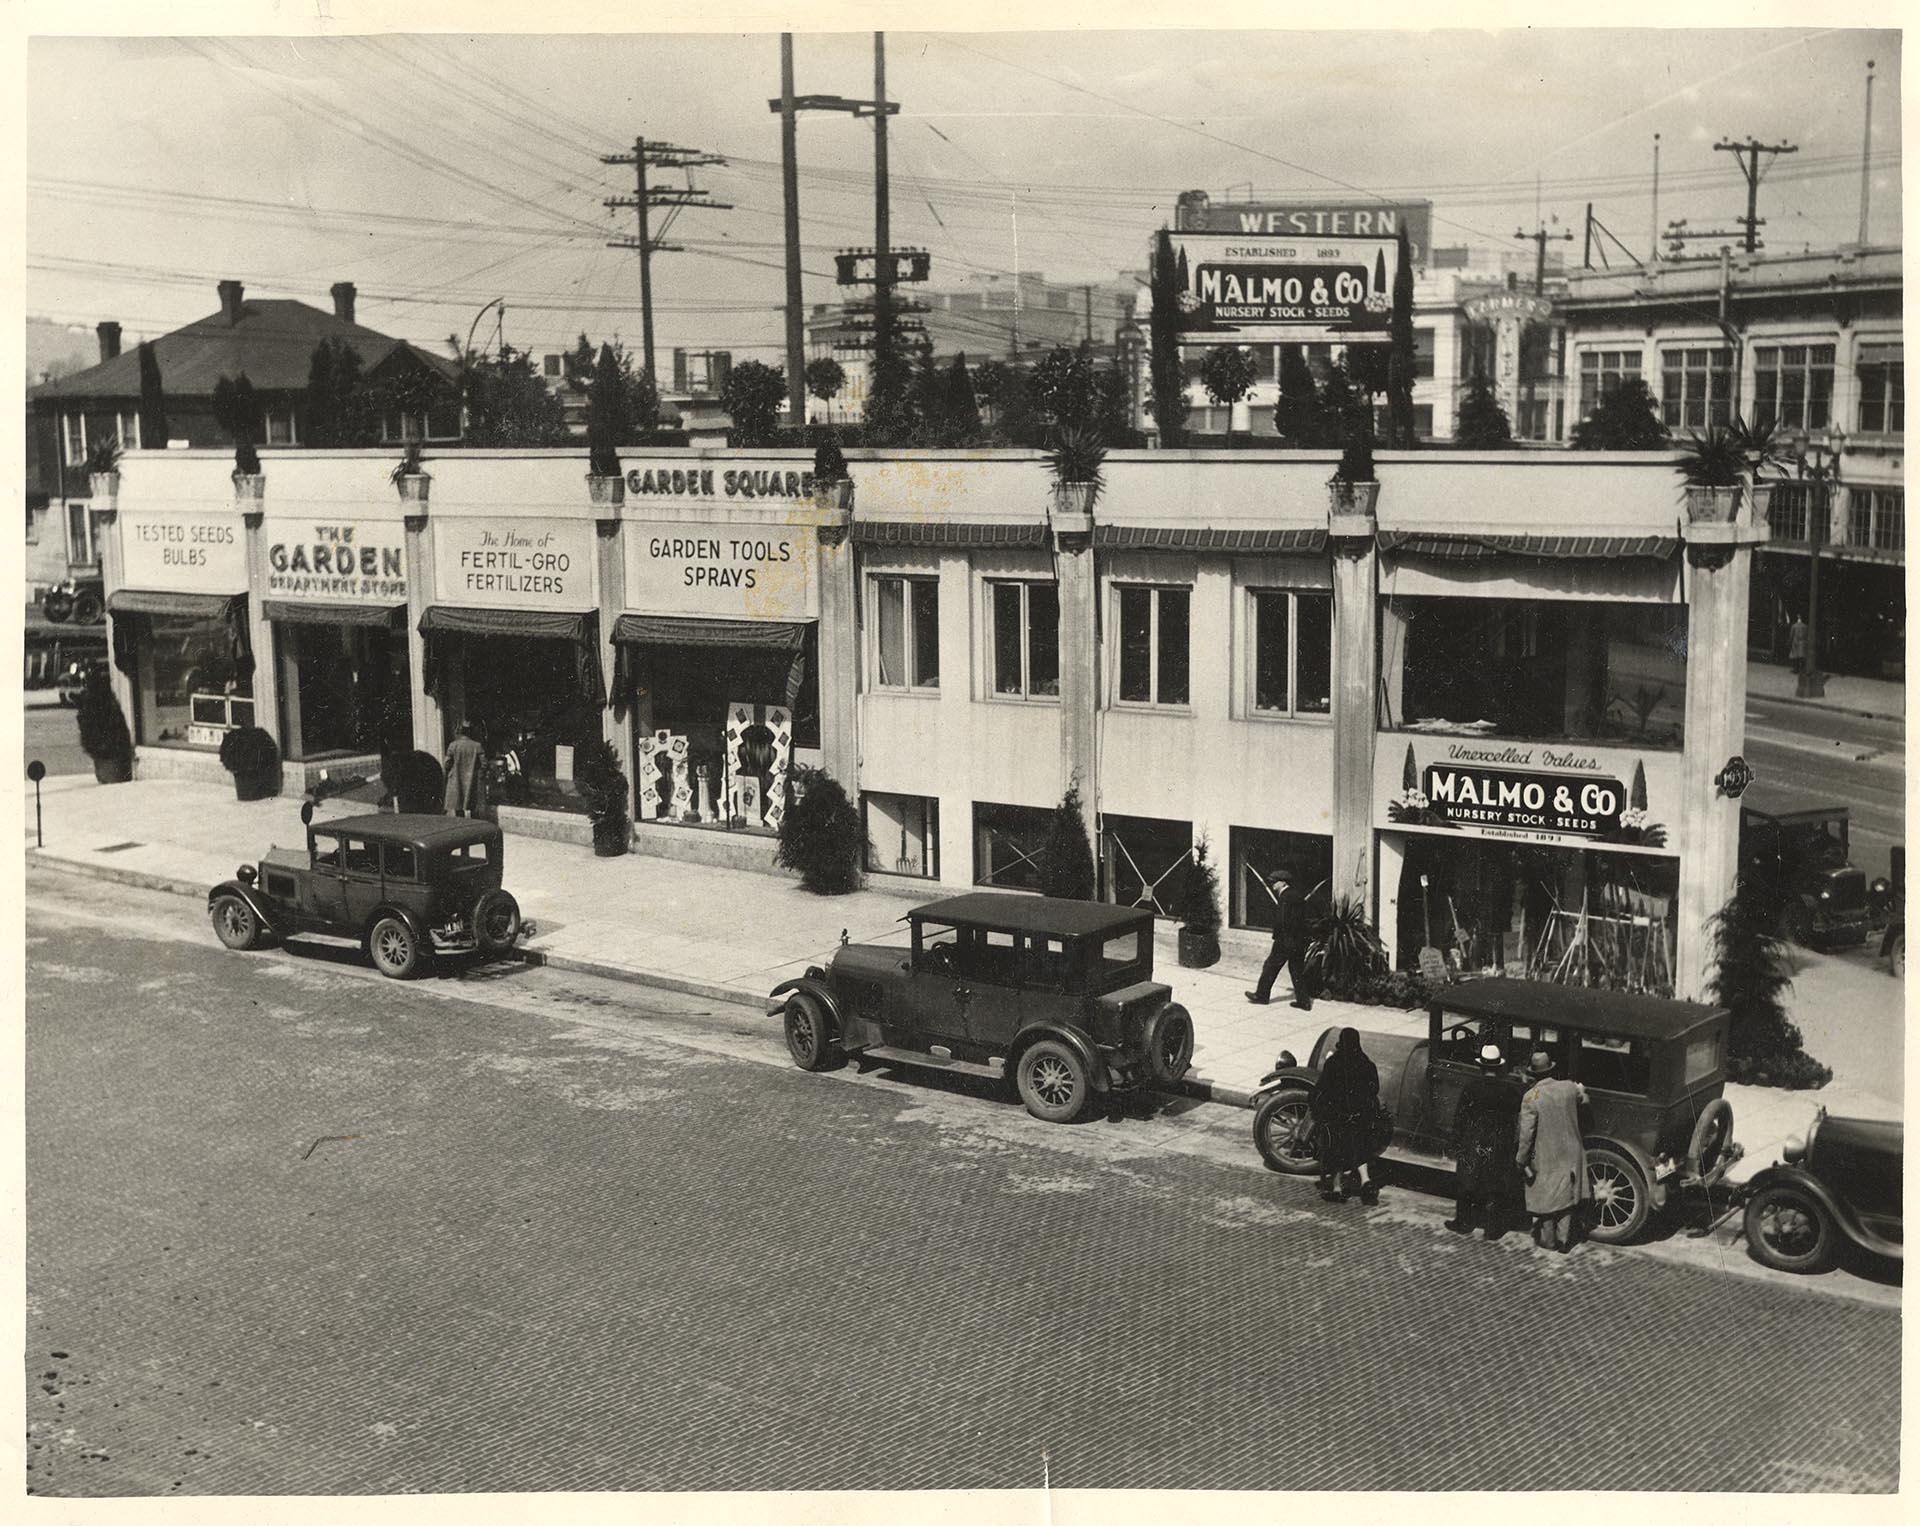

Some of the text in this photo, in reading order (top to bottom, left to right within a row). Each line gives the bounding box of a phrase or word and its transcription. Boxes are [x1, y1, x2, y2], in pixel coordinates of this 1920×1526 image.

[1239, 210, 1397, 234] WESTERN
[1225, 247, 1297, 258] ESTABLISHED
[1201, 269, 1303, 304] MALMO
[1310, 277, 1330, 306] &
[1214, 306, 1350, 319] NURSERY STOCK SEEDS
[626, 468, 816, 498] GARDEN SQUARE
[135, 524, 235, 544] TESTED SEEDS
[315, 525, 355, 543] THE
[480, 530, 499, 547] The
[504, 528, 534, 548] Home
[163, 548, 207, 567] BULBS
[268, 543, 403, 578] GARDEN
[650, 537, 791, 562] GARDEN TOOLS
[460, 551, 571, 573] FERTIL-GRO
[269, 574, 407, 597] DEPARTMENT STORE
[466, 573, 564, 594] FERTILIZERS
[683, 565, 757, 589] SPRAYS
[1447, 744, 1602, 770] Unexcelled Values
[1431, 771, 1545, 811] MALMO
[1553, 785, 1574, 815] &
[1446, 807, 1598, 831] NURSERY STOCK SEEDS
[1480, 827, 1529, 840] Established
